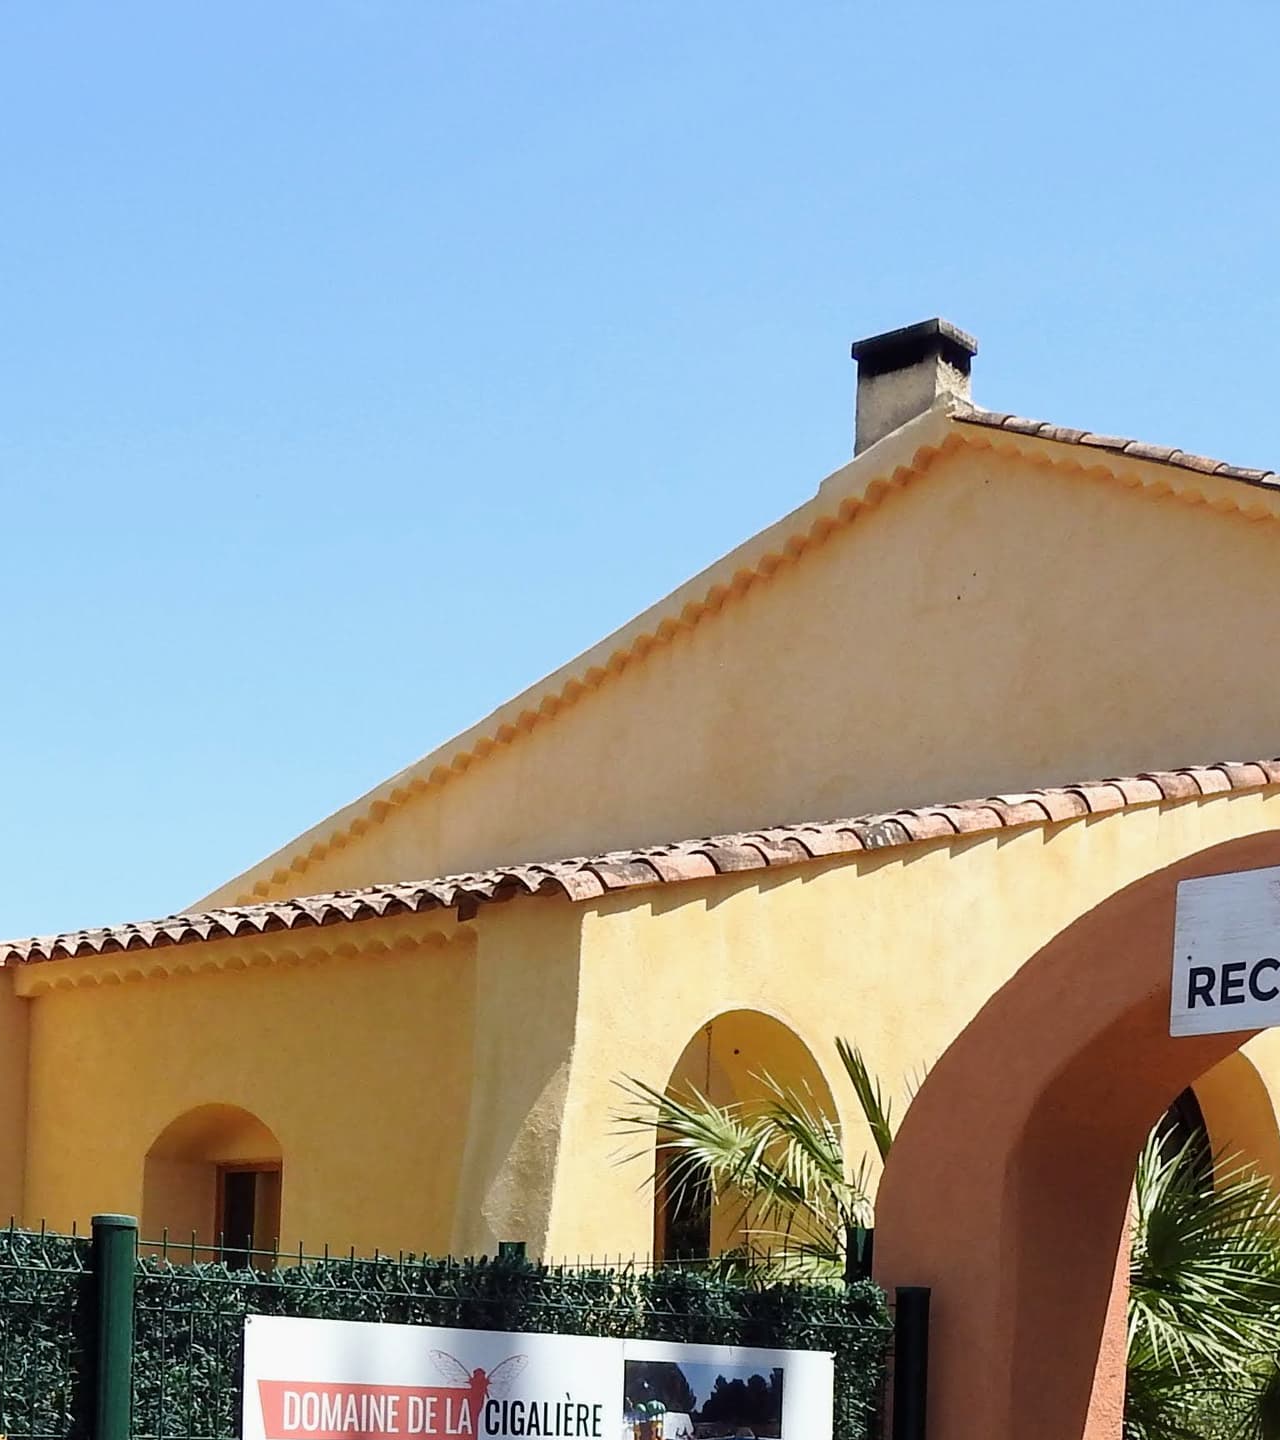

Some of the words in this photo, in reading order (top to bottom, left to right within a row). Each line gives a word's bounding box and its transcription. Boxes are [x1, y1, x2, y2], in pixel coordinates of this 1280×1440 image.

[283, 1391, 398, 1433] DOMAINE
[407, 1395, 437, 1434] DE
[445, 1396, 472, 1435] LA
[485, 1392, 603, 1437] CIGALIÈRE
